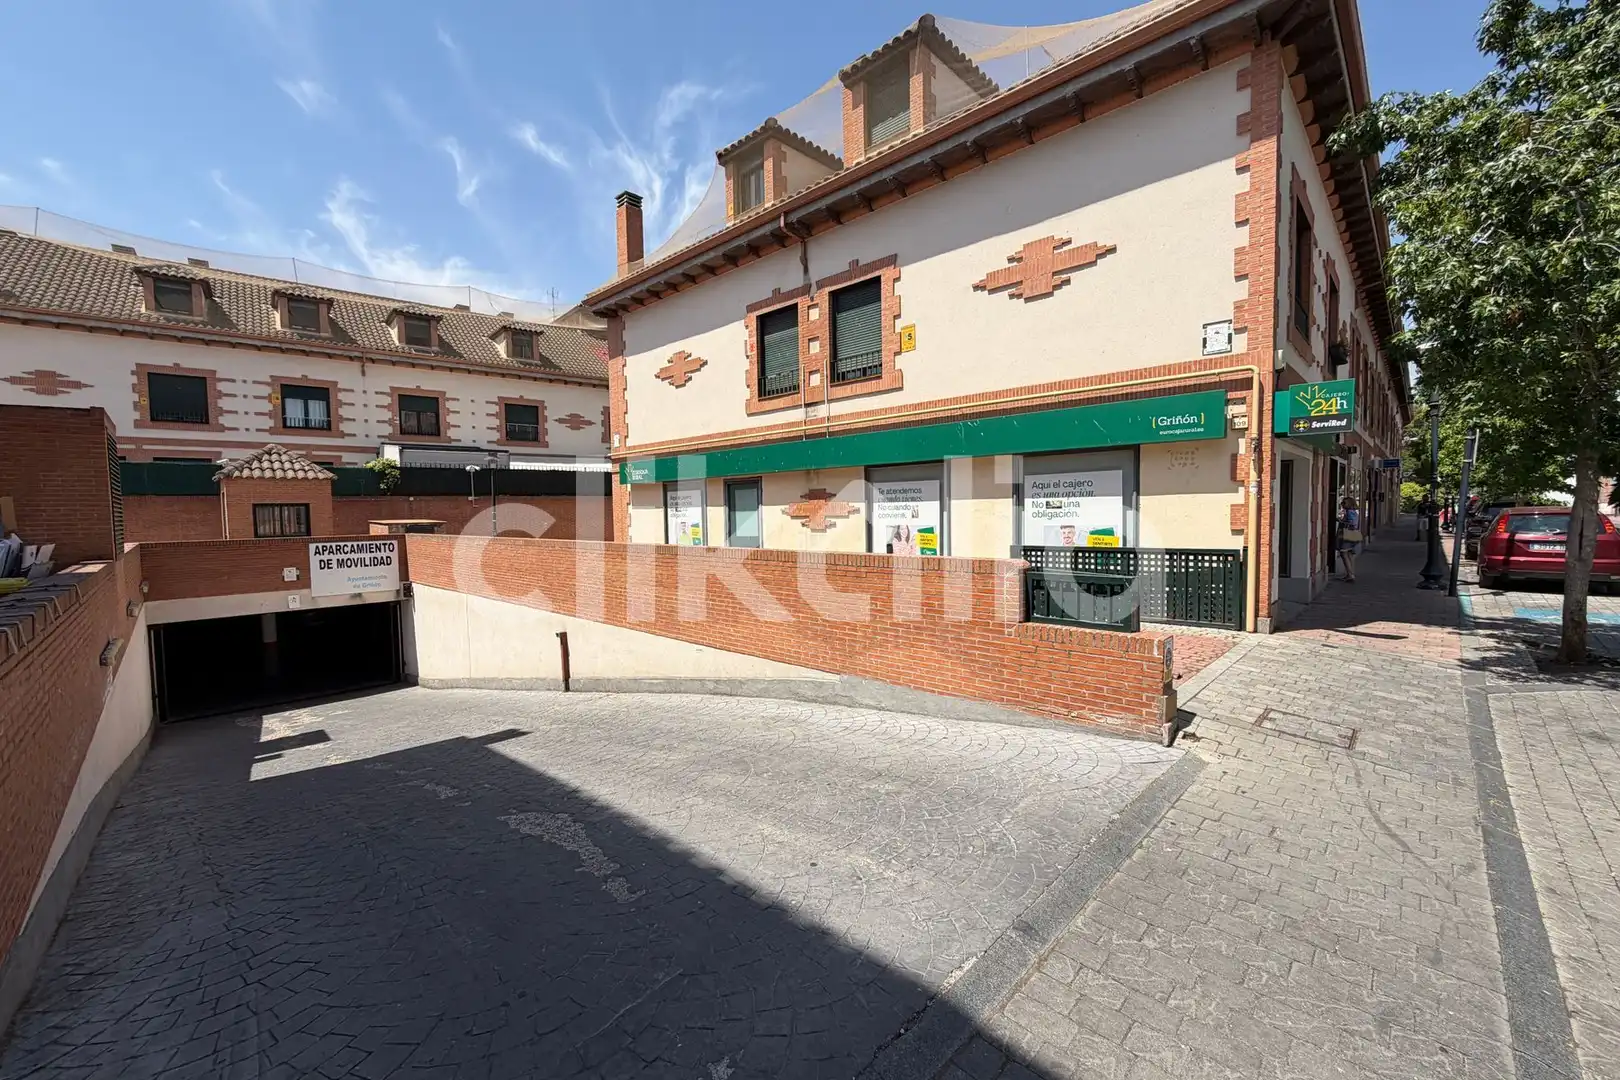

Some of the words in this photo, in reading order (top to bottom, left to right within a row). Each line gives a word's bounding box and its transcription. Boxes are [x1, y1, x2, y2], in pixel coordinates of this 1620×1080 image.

[1157, 413, 1198, 426] Griñón
[1311, 419, 1347, 428] ServiRed
[1052, 480, 1061, 489] el
[1062, 479, 1094, 490] cajero
[878, 487, 885, 495] Te
[885, 487, 922, 495] atendemos
[1031, 501, 1044, 509] No
[1031, 509, 1080, 520] obligación.
[313, 542, 395, 556] APARCAMIENTO
[319, 559, 333, 570] DE
[336, 556, 392, 569] MOVILIDAD
